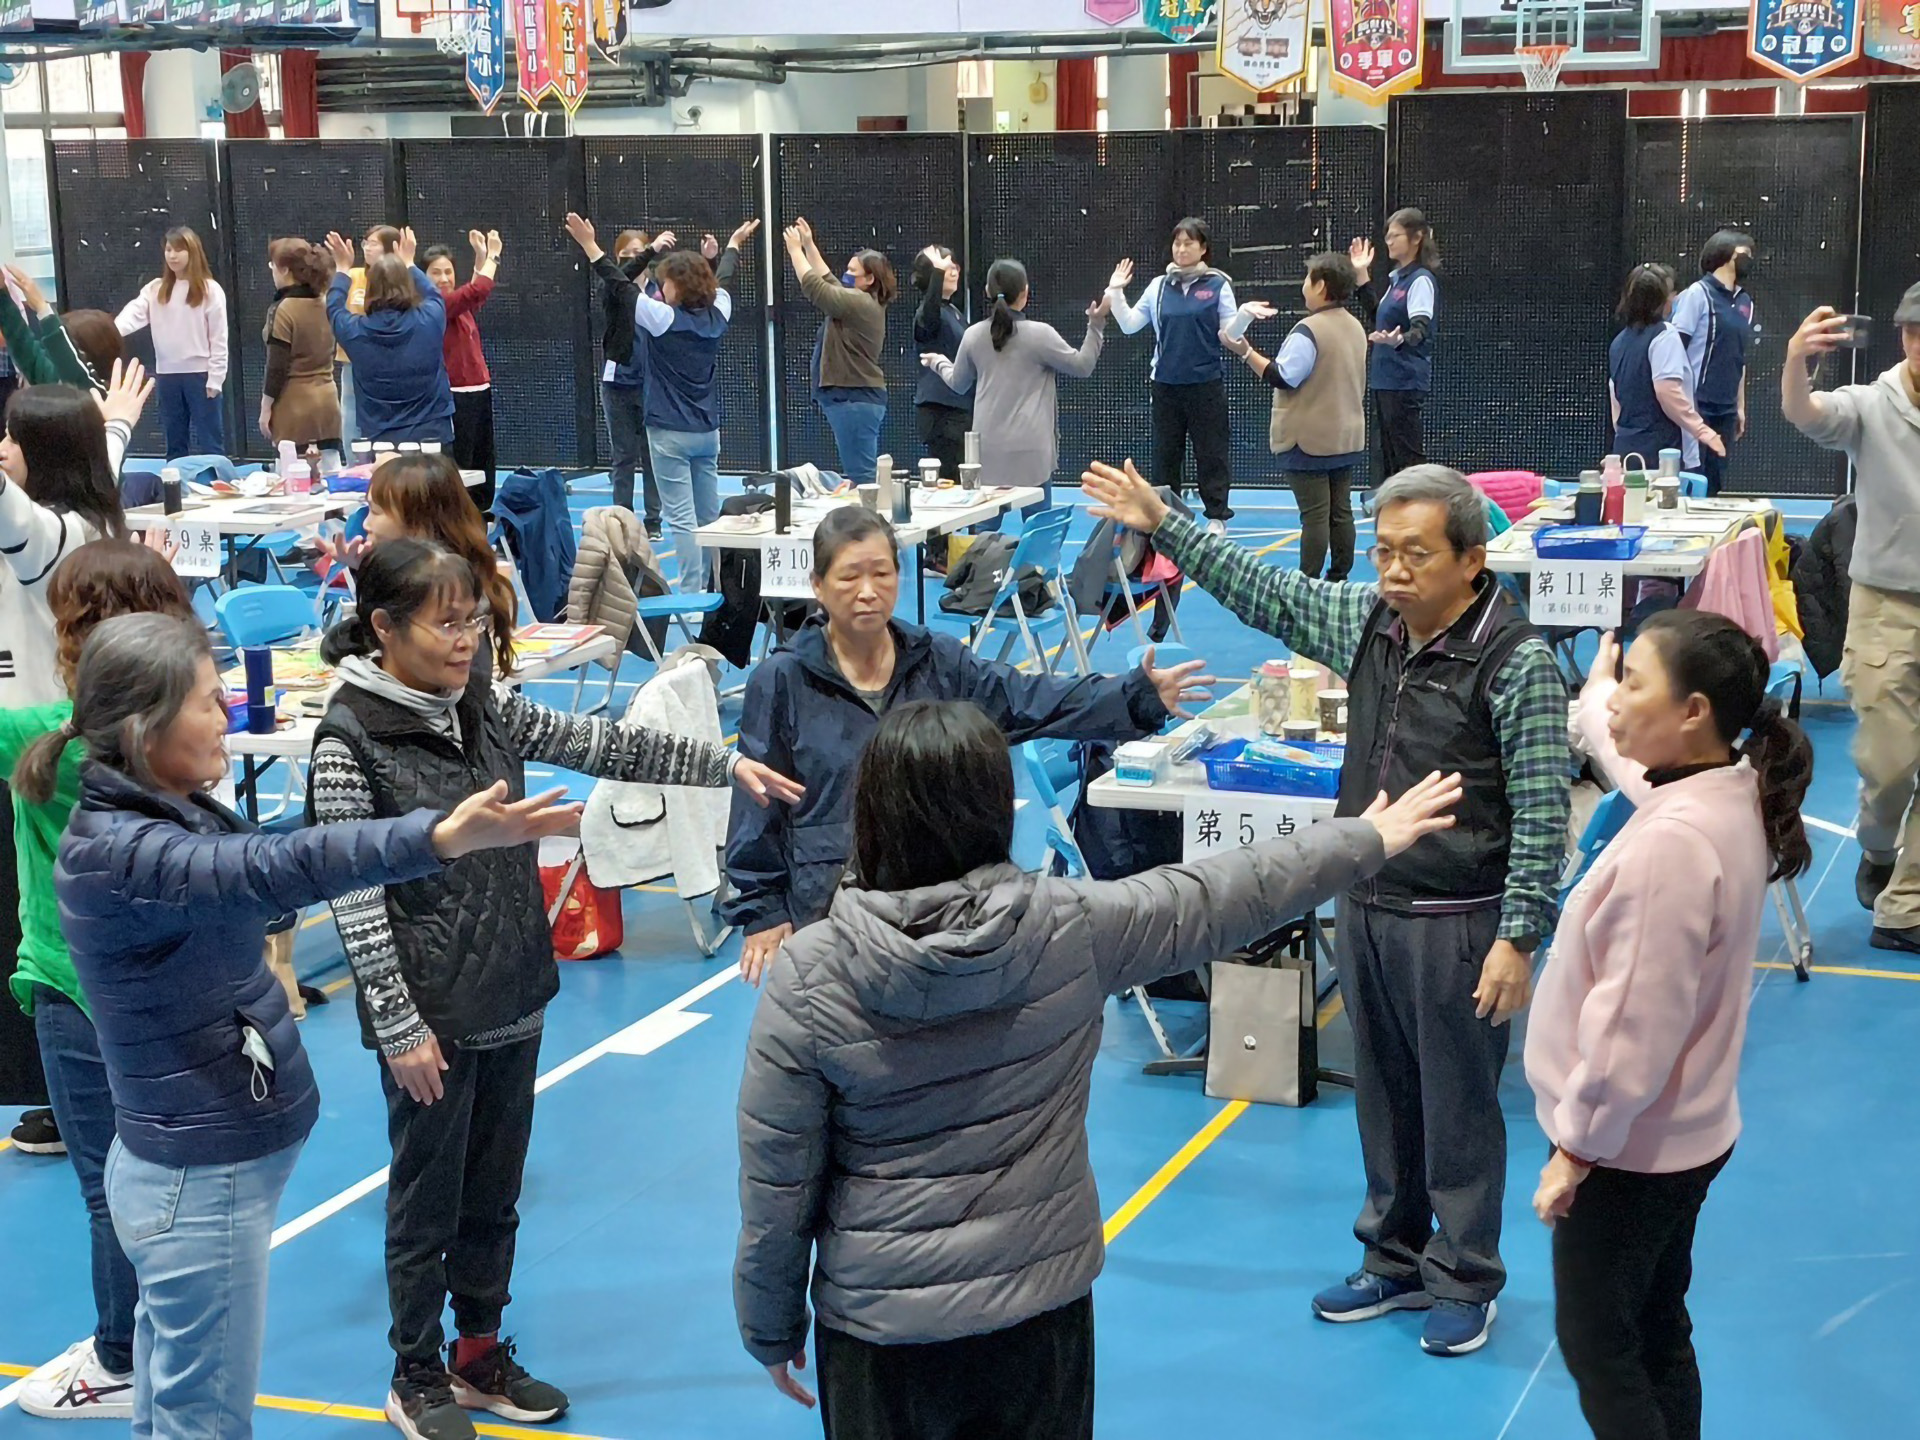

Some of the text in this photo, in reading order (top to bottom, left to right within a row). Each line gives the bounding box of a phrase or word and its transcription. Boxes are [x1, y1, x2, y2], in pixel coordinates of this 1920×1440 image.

[181, 529, 190, 550] 9
[199, 529, 215, 552] 桌
[766, 546, 808, 571] 第 10
[1536, 570, 1616, 599] 第 11 桌
[1194, 808, 1222, 848] 第
[1239, 812, 1255, 846] 5
